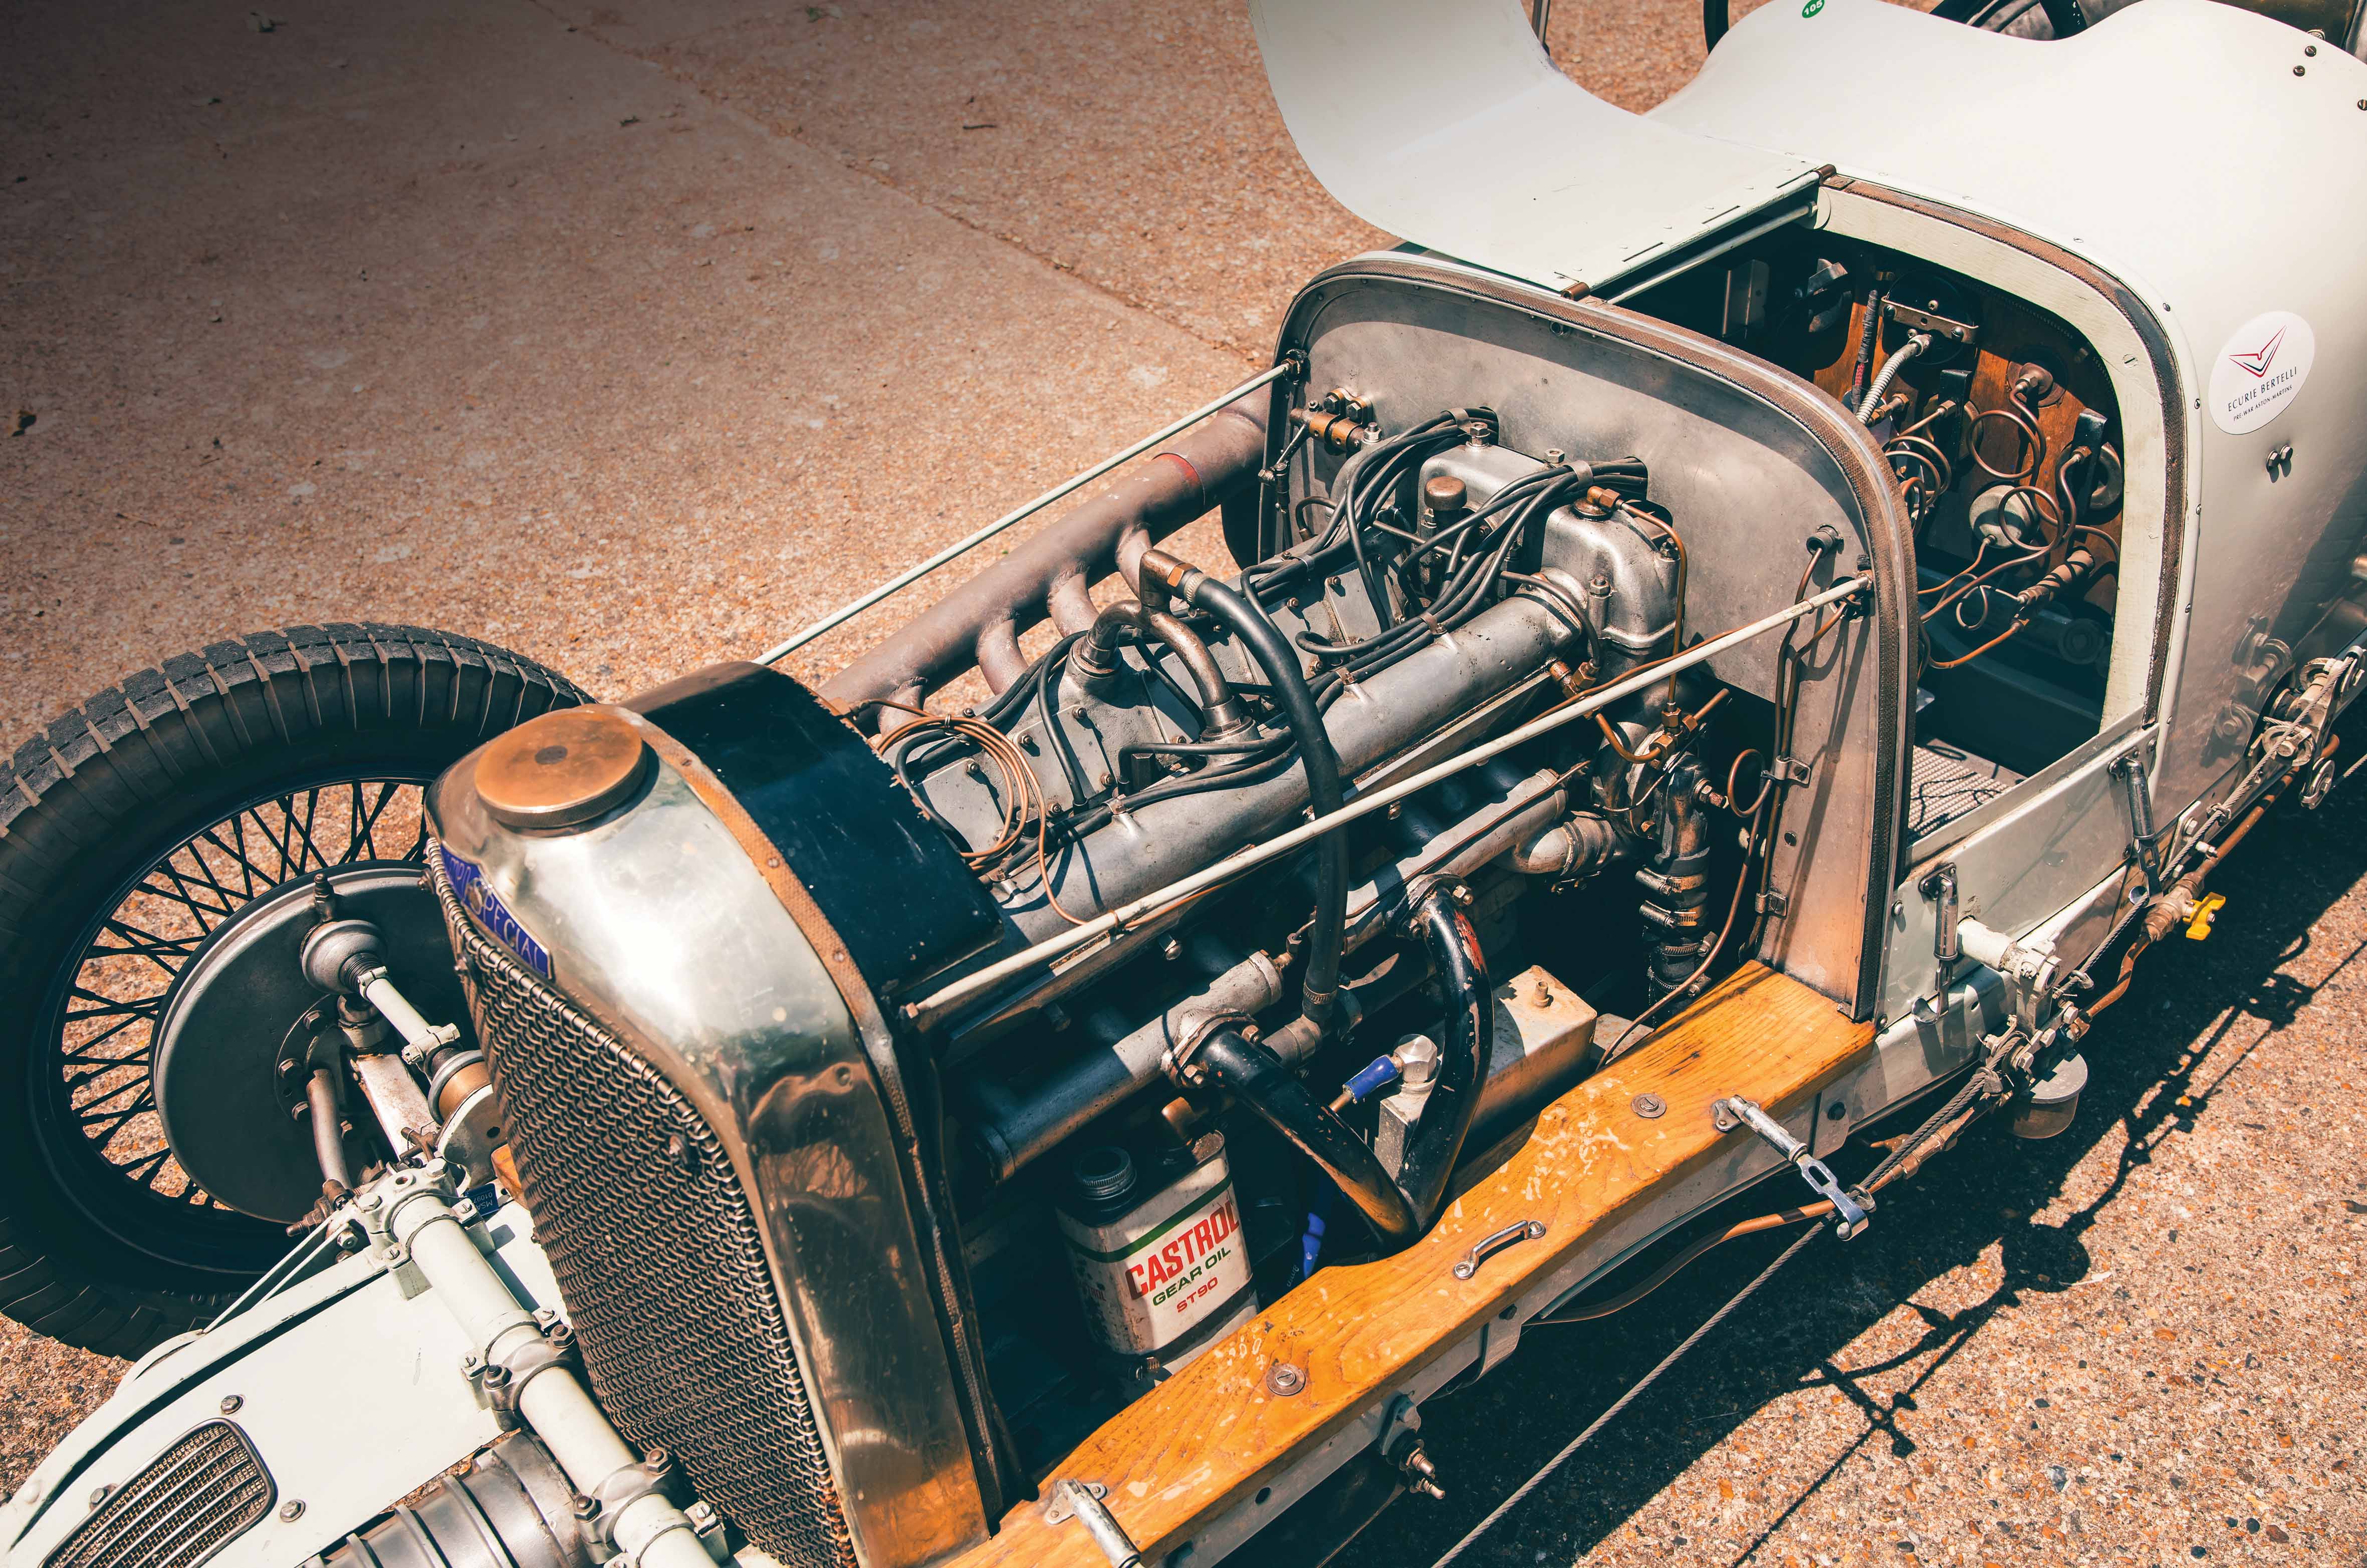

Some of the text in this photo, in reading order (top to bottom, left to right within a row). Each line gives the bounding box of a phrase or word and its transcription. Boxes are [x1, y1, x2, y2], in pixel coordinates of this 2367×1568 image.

[1804, 0, 1823, 15] 105
[2228, 366, 2297, 412] ECURIE BERTELLI
[2233, 406, 2254, 421] PRE-WAR
[469, 877, 546, 975] SPECIAL
[1125, 1201, 1240, 1300] CASTROL
[1152, 1246, 1232, 1306] GEAR OIL
[1176, 1276, 1219, 1313] ST90
